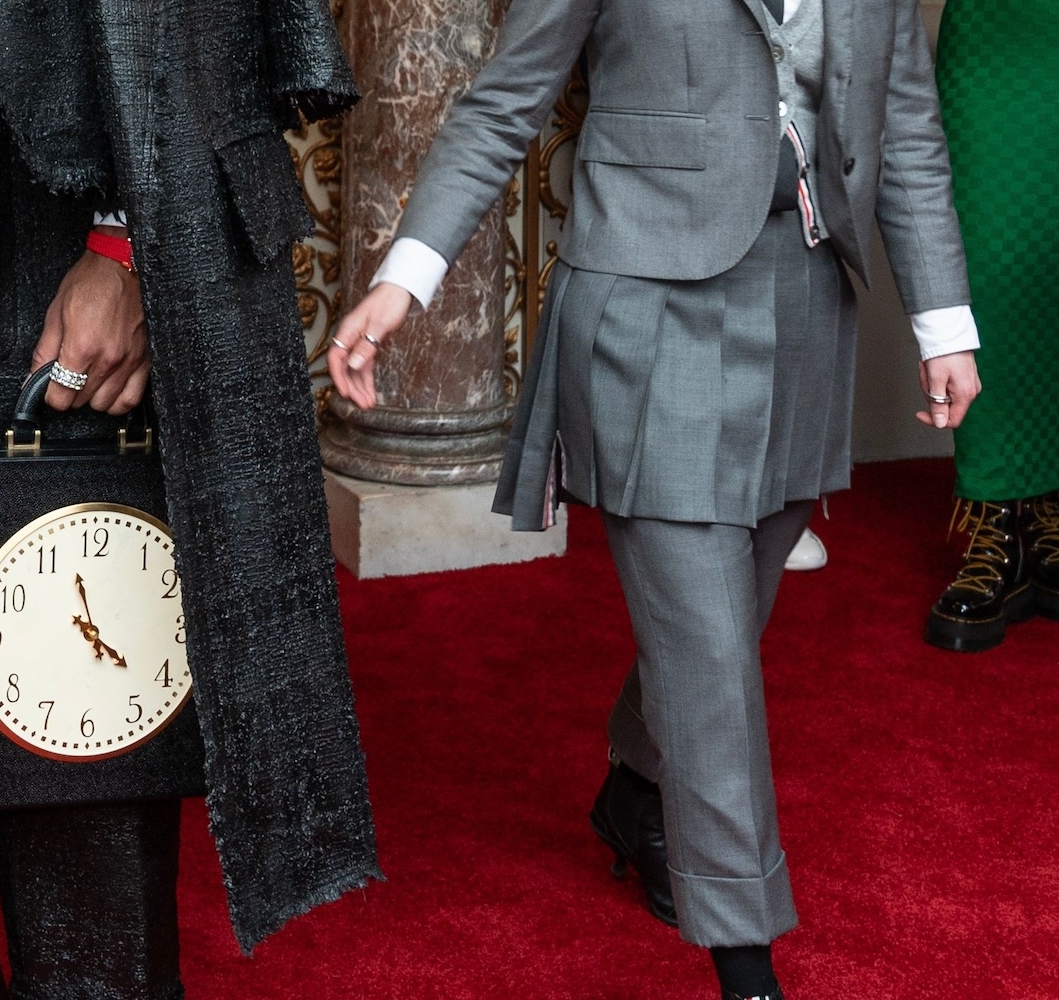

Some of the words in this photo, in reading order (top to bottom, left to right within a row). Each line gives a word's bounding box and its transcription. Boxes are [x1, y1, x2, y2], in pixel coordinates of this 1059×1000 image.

[82, 527, 109, 558] 12
[141, 542, 148, 571] 1
[37, 545, 57, 574] 11
[2, 584, 26, 614] 10
[161, 569, 179, 599] 2
[6, 673, 20, 703] 8
[154, 658, 174, 688] 4
[38, 700, 55, 731] 7
[80, 708, 95, 738] 6
[125, 694, 143, 724] 5
